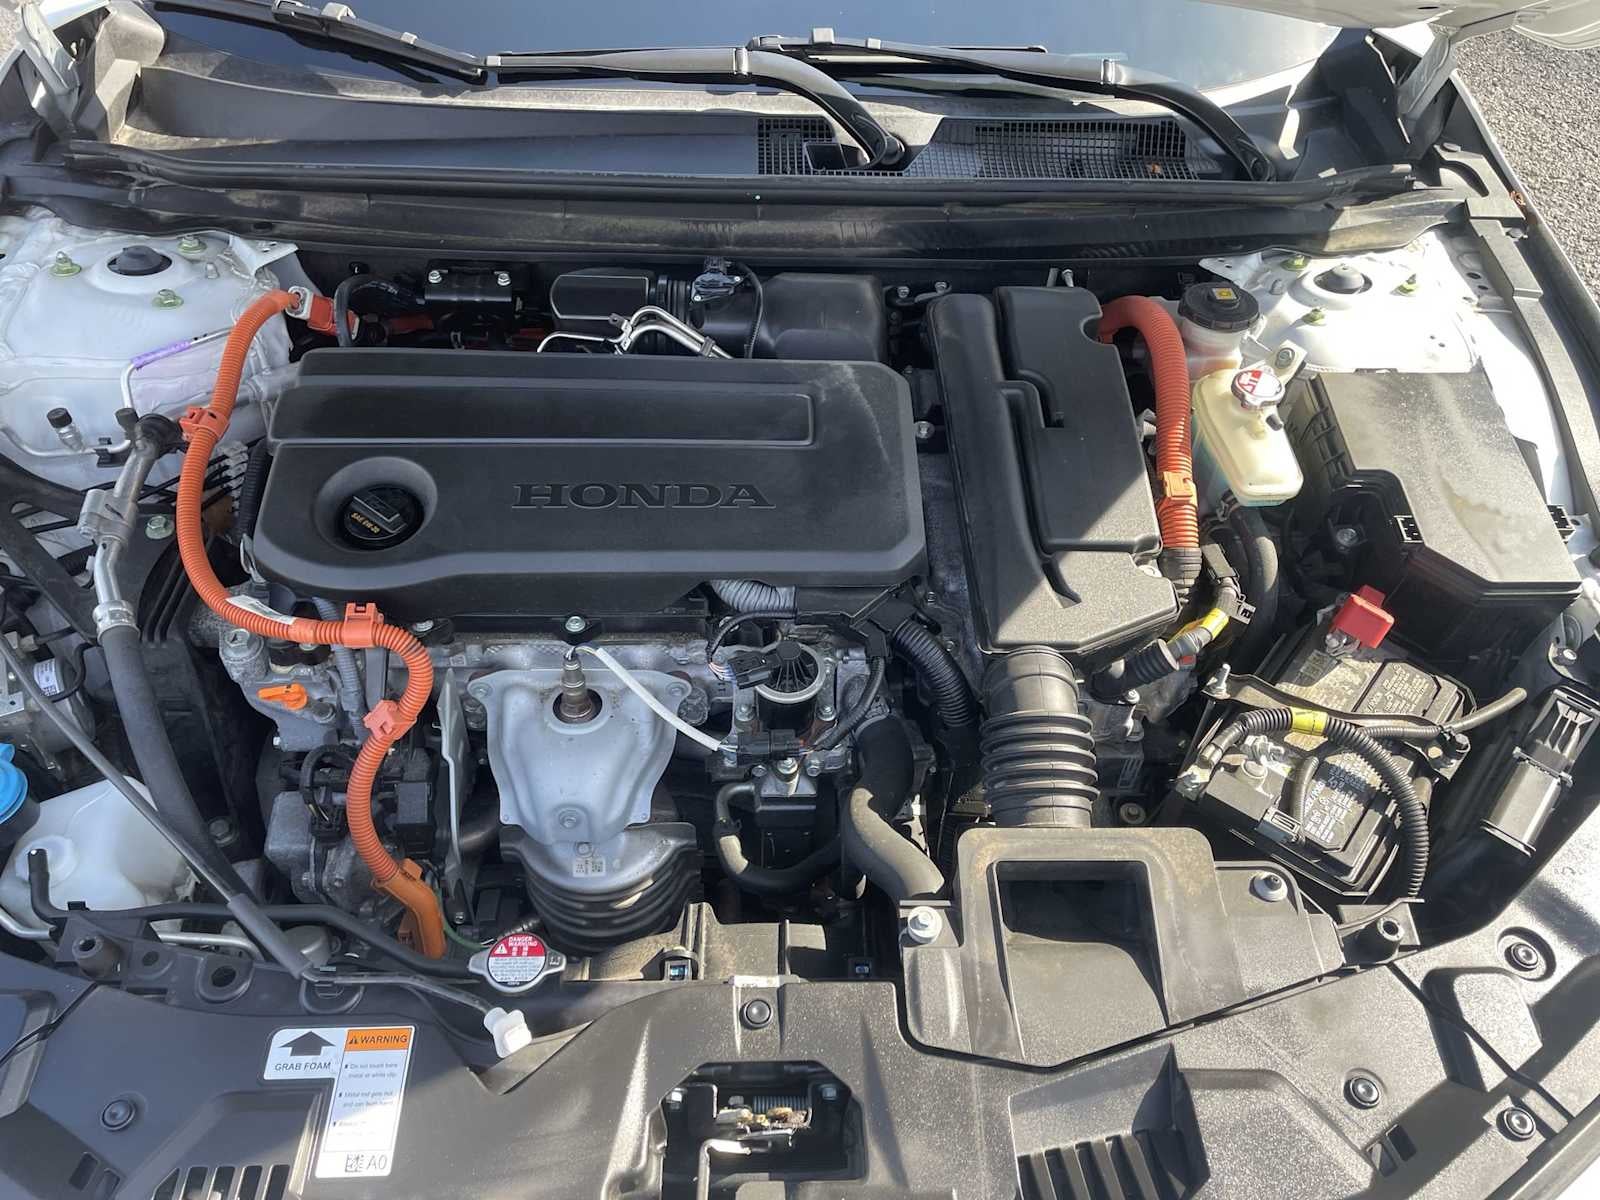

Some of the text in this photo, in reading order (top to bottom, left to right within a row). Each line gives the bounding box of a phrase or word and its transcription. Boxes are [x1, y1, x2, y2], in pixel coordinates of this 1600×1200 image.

[511, 482, 776, 509] HONDA
[351, 512, 365, 523] SAE
[361, 1034, 408, 1044] WARNING
[274, 1061, 332, 1072] GRAB FOAM
[366, 1154, 387, 1170] A0
